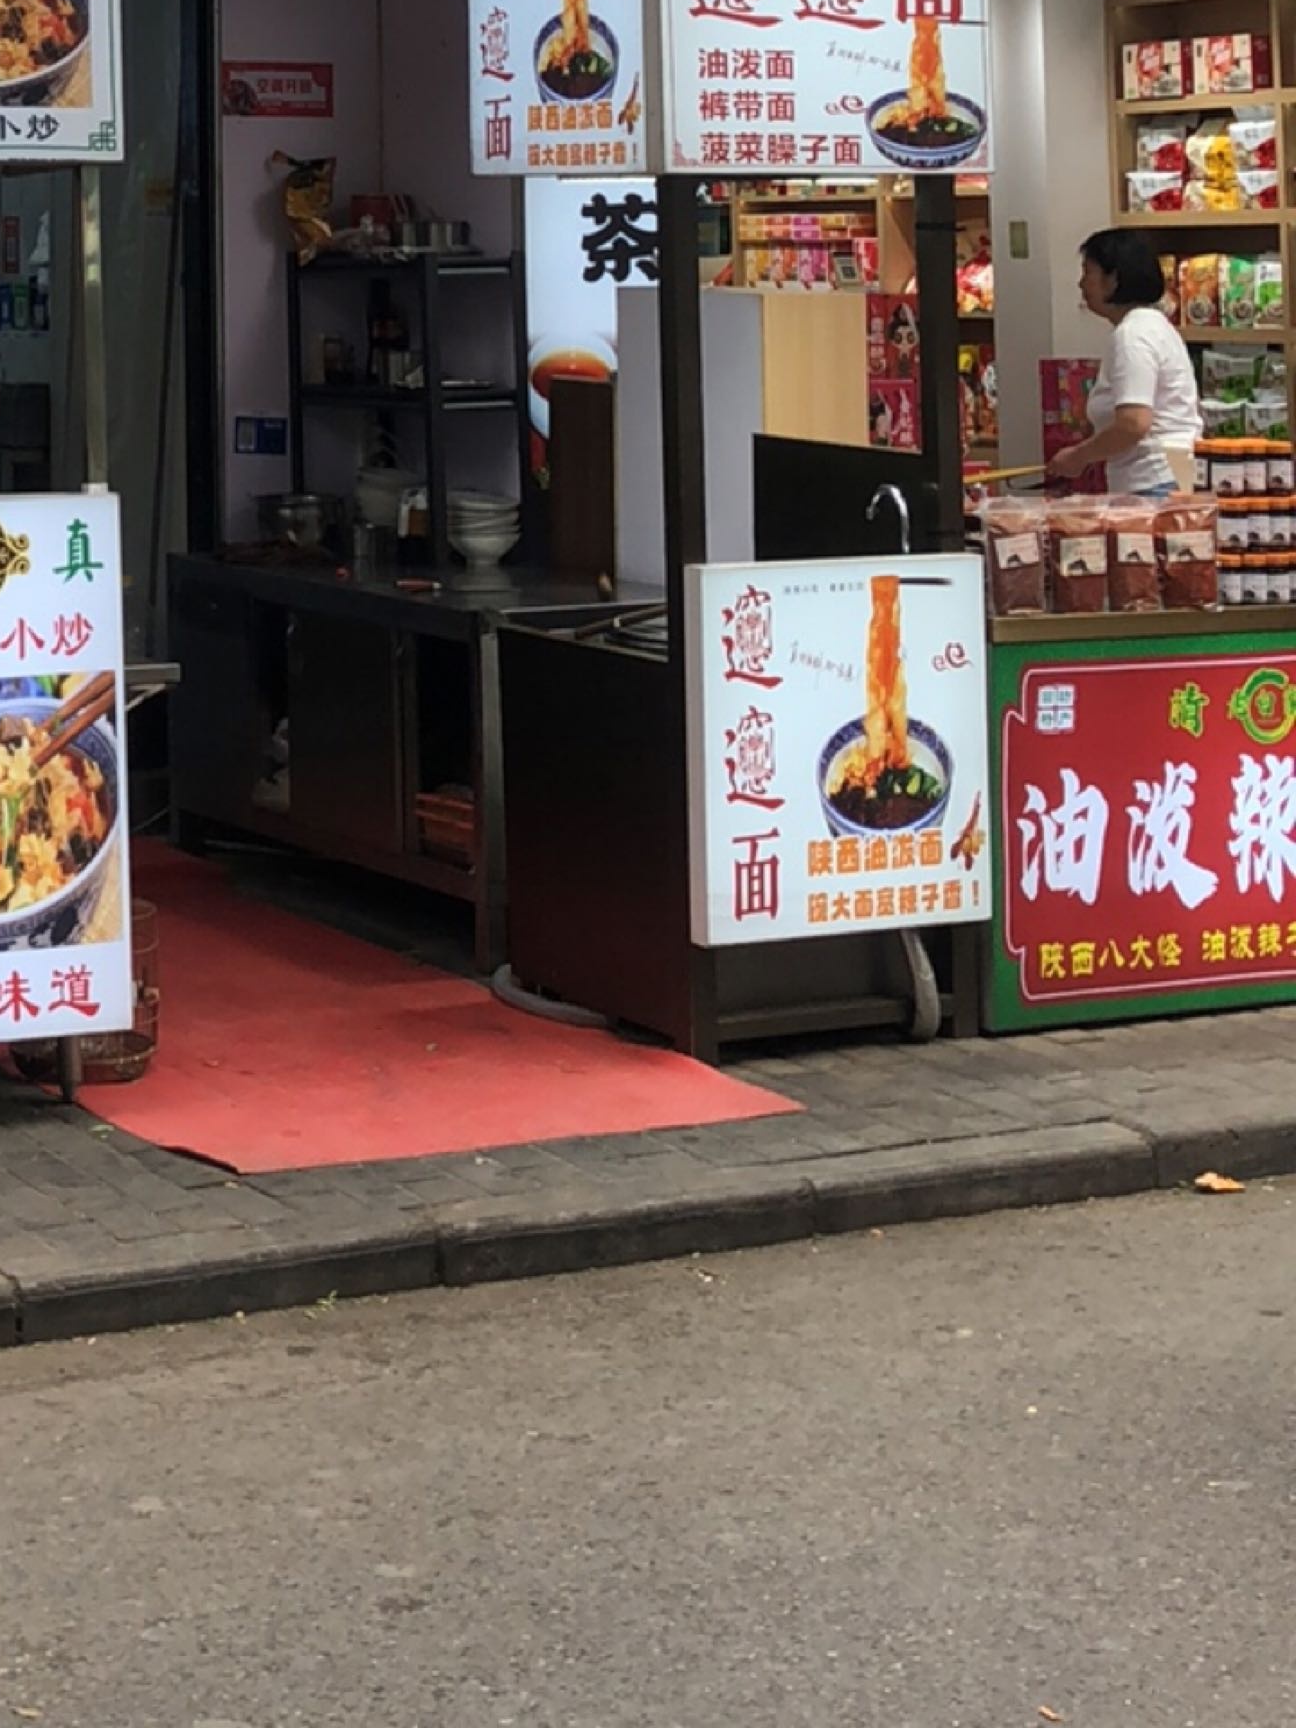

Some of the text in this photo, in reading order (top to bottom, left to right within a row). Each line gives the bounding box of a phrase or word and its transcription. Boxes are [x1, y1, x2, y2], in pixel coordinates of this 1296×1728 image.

[697, 48, 796, 81] 油泼面
[697, 90, 796, 123] 裤带面
[699, 133, 862, 165] 菠菜臊子面
[581, 193, 659, 283] 茶
[53, 518, 104, 583] 真
[808, 830, 942, 877] 陕西油泼面
[1038, 933, 1183, 979] 陕西八大怪
